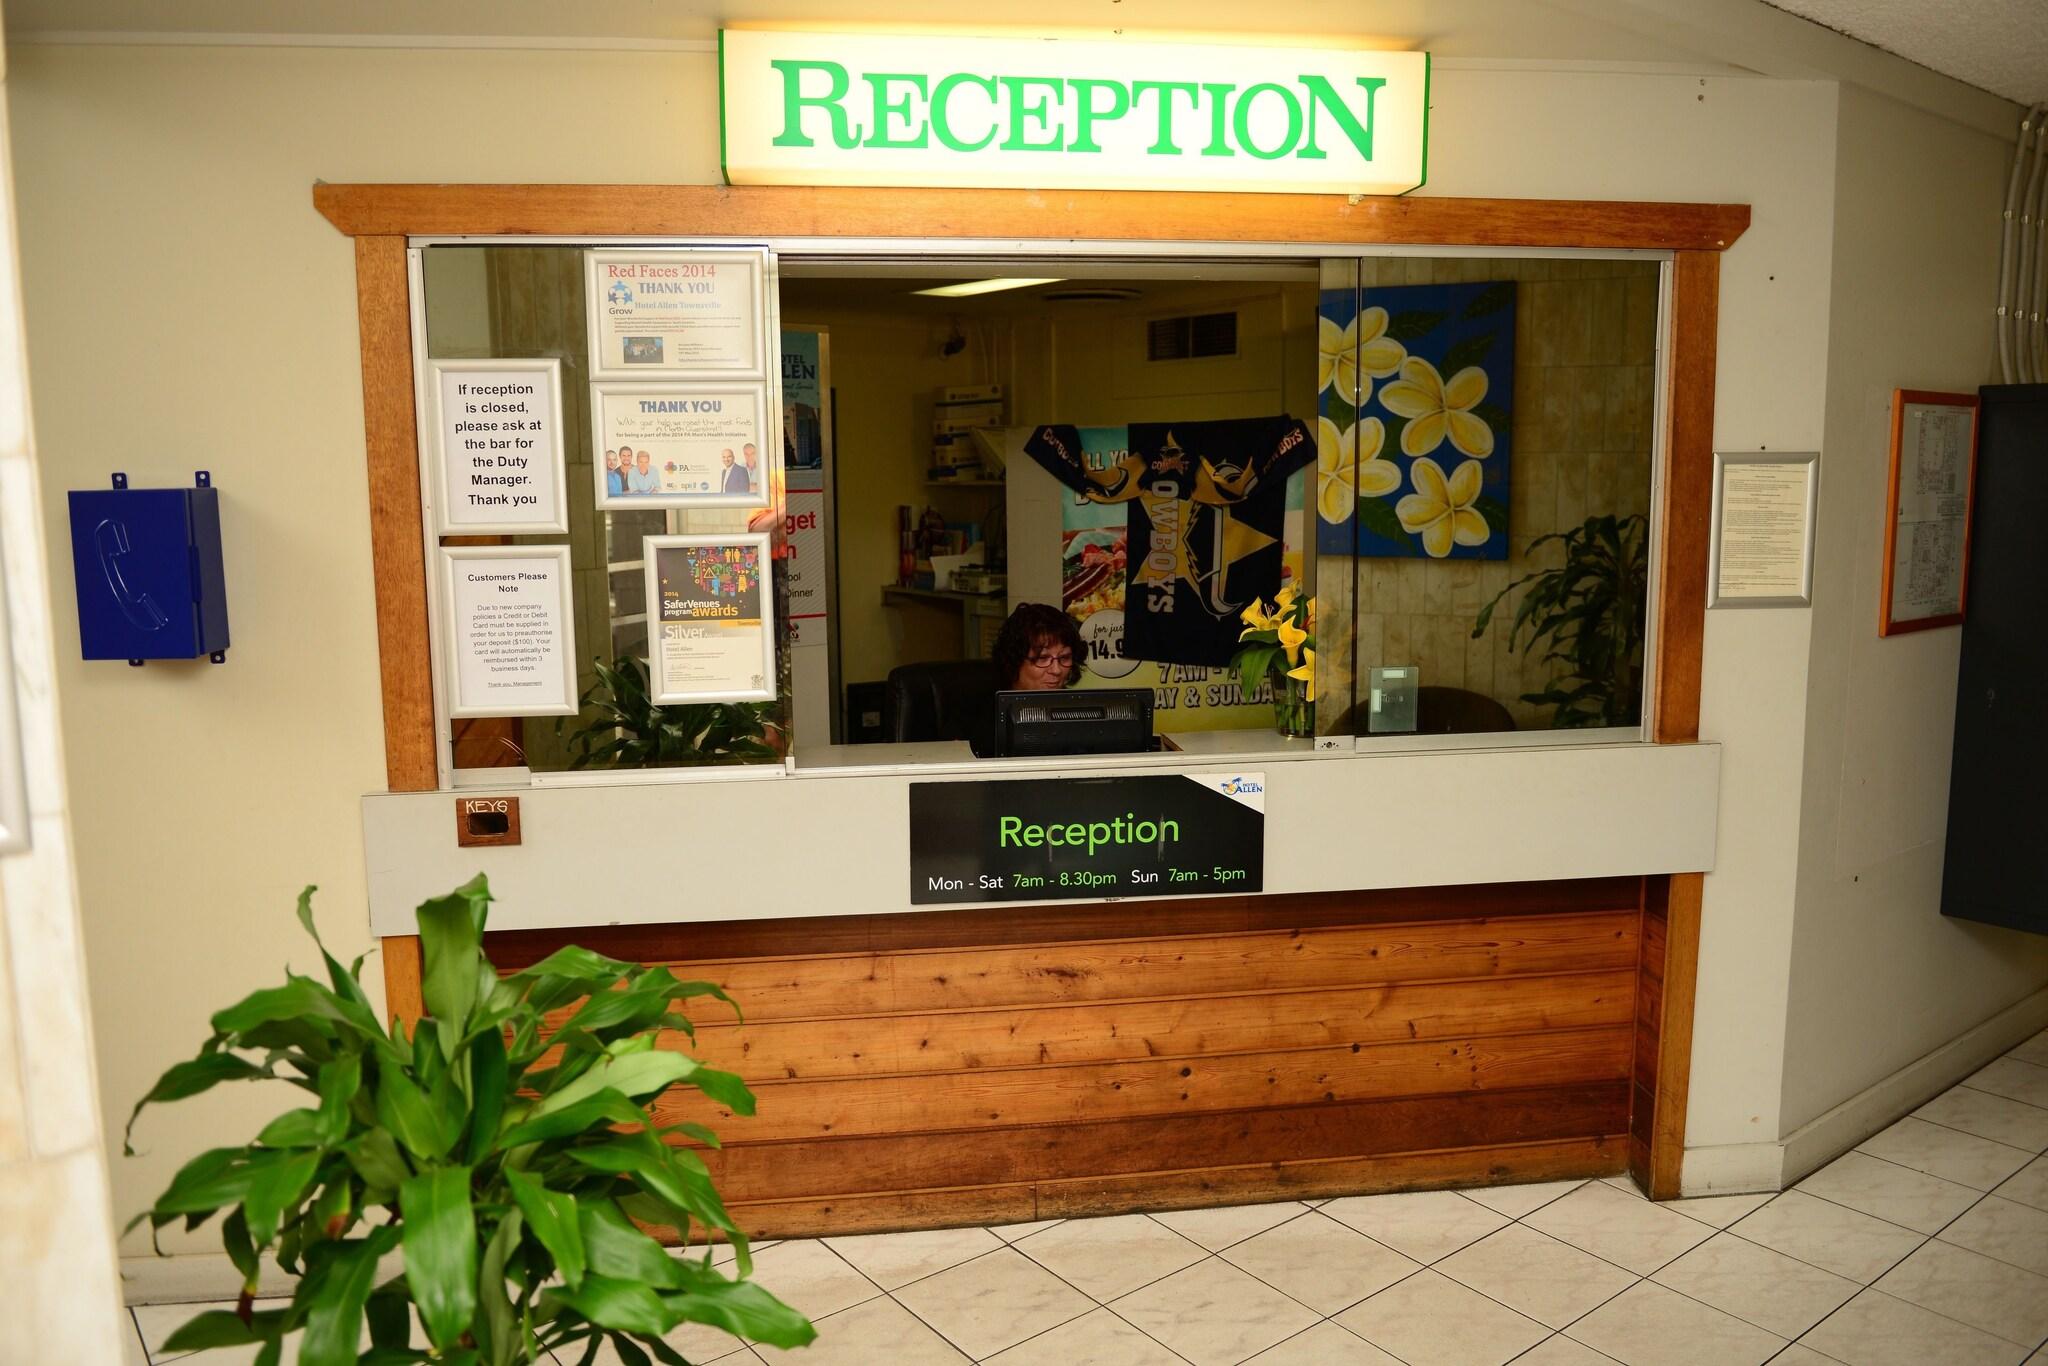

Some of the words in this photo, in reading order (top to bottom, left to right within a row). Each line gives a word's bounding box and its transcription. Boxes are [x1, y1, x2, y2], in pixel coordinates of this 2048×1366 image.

[771, 59, 1387, 162] RECEPTION
[608, 264, 636, 278] Red
[640, 264, 679, 278] Faces
[682, 264, 717, 278] 2014
[637, 282, 684, 294] THANK
[688, 282, 715, 294] YOU
[609, 307, 633, 315] Grow
[635, 301, 656, 309] Hotel
[658, 301, 678, 309] Allen
[458, 384, 467, 395] If
[471, 384, 533, 397] reception
[466, 403, 477, 413] is
[481, 402, 529, 414] closed,
[639, 401, 688, 413] THANK
[692, 400, 722, 412] YOU
[455, 421, 498, 434] please
[502, 420, 525, 431] ask
[529, 420, 542, 430] at
[465, 439, 486, 449] the
[490, 438, 511, 449] bar
[515, 438, 534, 448] for
[473, 457, 494, 467] the
[498, 456, 528, 469] Duty
[472, 475, 532, 487] Manager.
[468, 494, 509, 505] Thank
[513, 495, 537, 507] you
[468, 573, 516, 582] Customers
[518, 572, 548, 581] Please
[498, 585, 519, 593] Note
[514, 604, 542, 612] company
[664, 600, 721, 609] SaferVenues
[473, 613, 496, 621] policies
[516, 621, 541, 629] supplied
[514, 629, 553, 638] preauthorise
[665, 625, 705, 640] Silver
[488, 639, 511, 647] deposit
[501, 647, 541, 656] automatically
[483, 656, 518, 664] reimbursed
[1184, 686, 1201, 708] &
[466, 800, 508, 814] KEYS
[1000, 813, 1180, 856] Reception
[928, 877, 963, 891] Mon
[979, 875, 1004, 889] Sat
[1013, 874, 1044, 888] 7am
[1059, 871, 1117, 890] 8.30pm
[1131, 869, 1159, 884] Sun
[1168, 868, 1198, 882] 7am
[1213, 867, 1246, 884] 5pm
